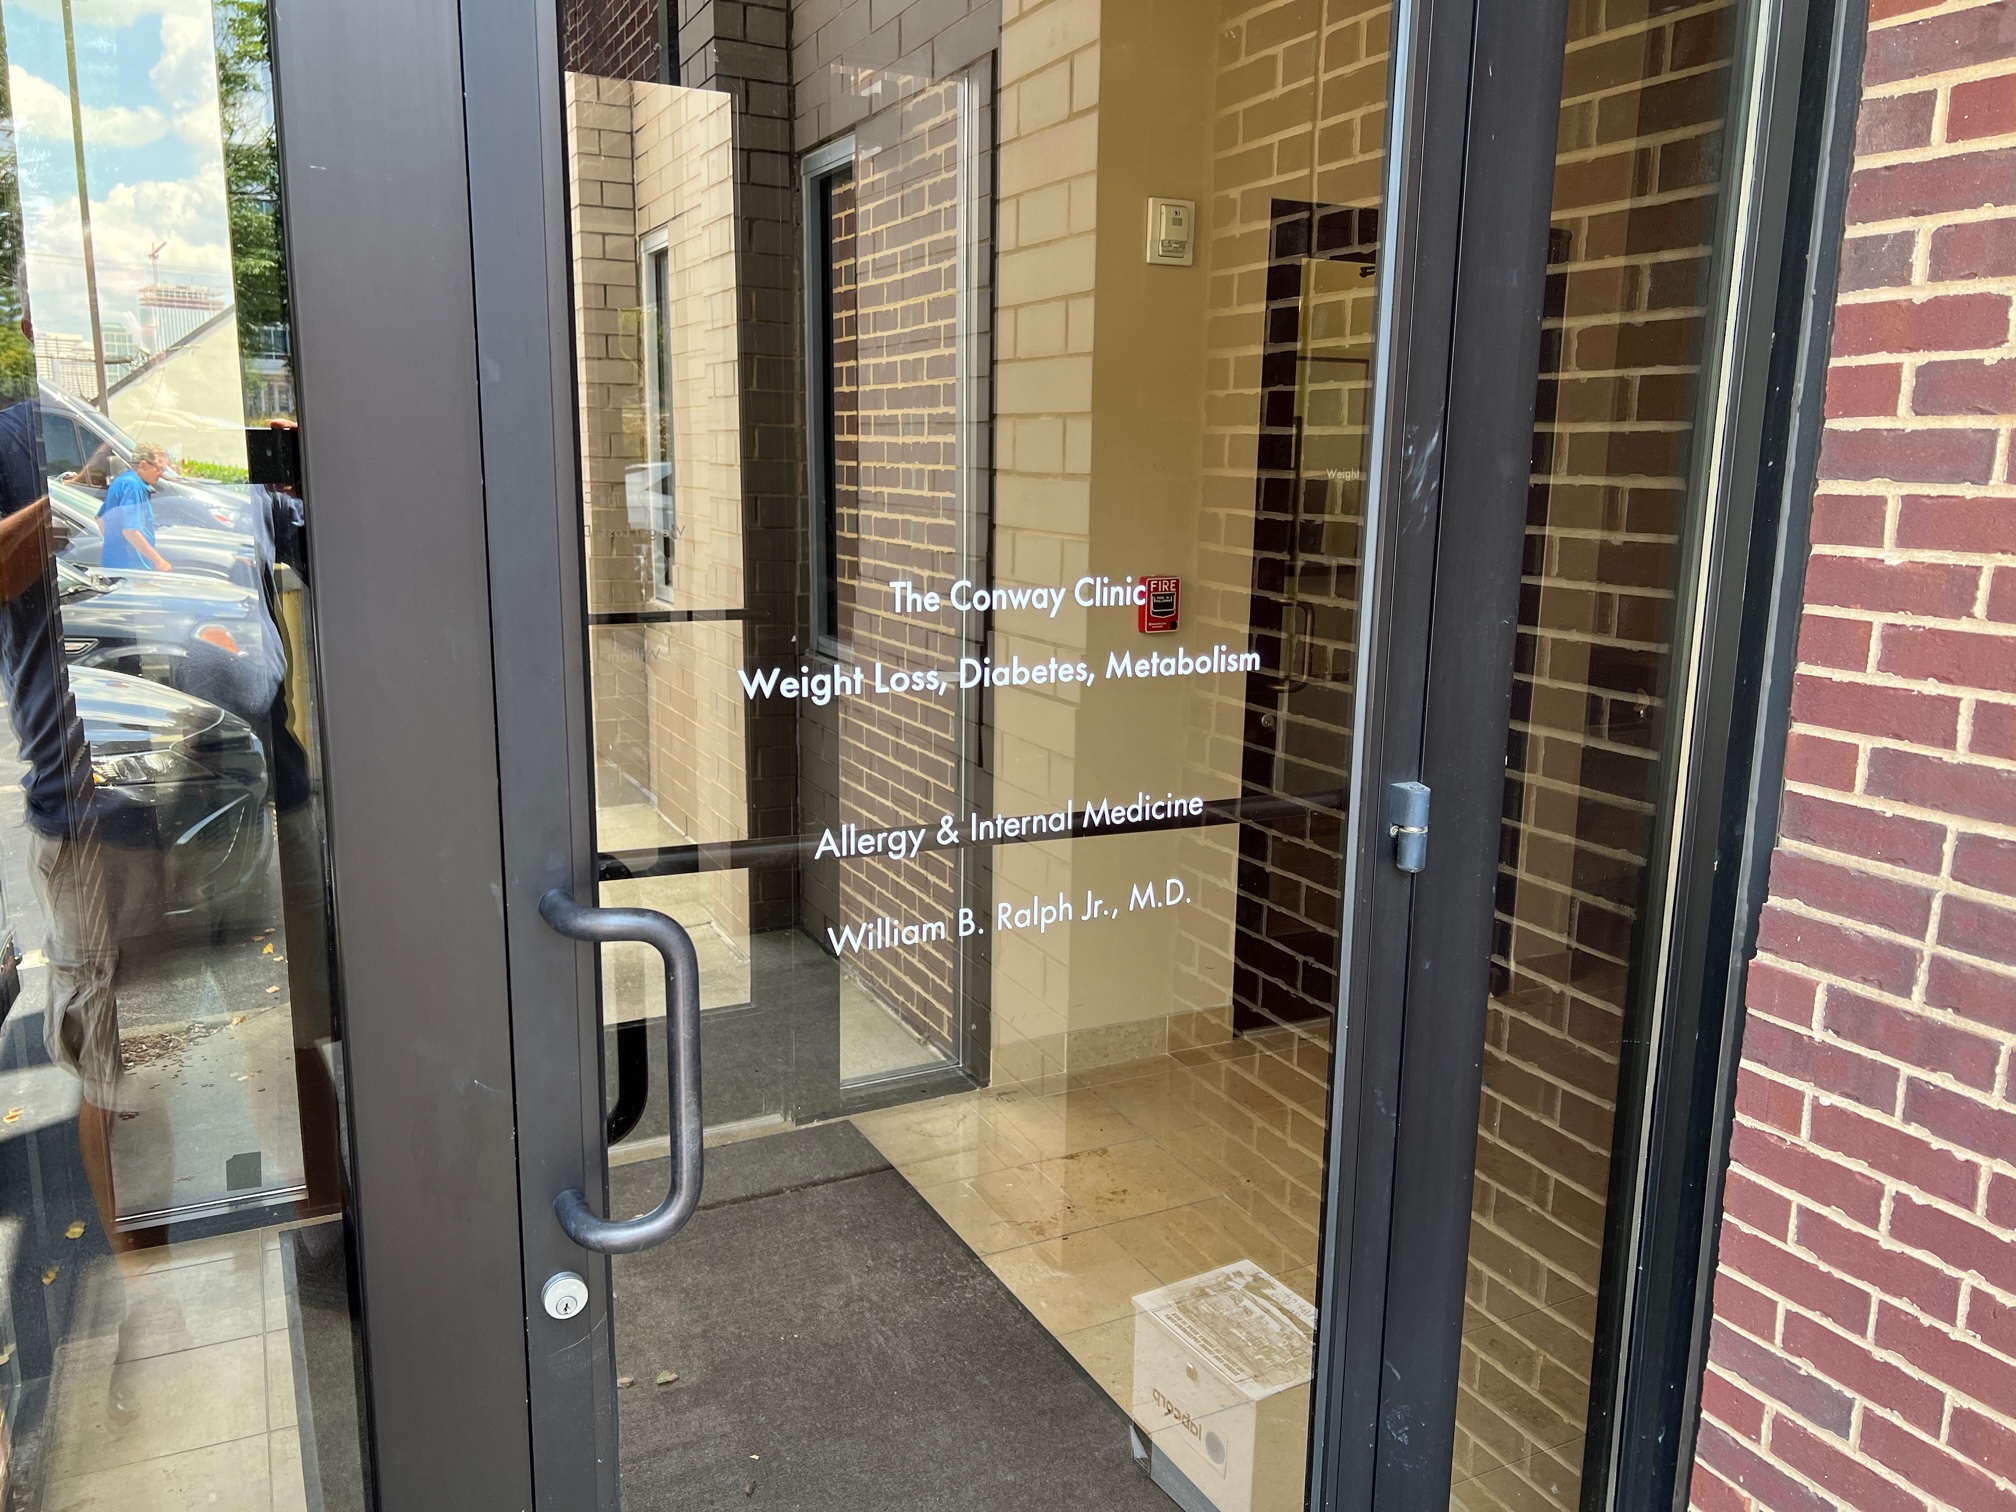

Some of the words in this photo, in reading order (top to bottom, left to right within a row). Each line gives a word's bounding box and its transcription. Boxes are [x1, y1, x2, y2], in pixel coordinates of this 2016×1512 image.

[1326, 468, 1361, 481] Weight
[889, 581, 941, 613] The
[950, 580, 1067, 619] Conway
[1074, 575, 1146, 607] Clinic
[1150, 579, 1177, 592] FIRE
[738, 664, 865, 706] Weight
[874, 661, 948, 696] Loss,
[959, 657, 1095, 693] Diabetes,
[1105, 645, 1260, 679] Metabolism
[814, 824, 926, 860] Allergy
[937, 816, 960, 845] &
[971, 800, 1073, 841] Internal
[1083, 792, 1204, 828] Medicine
[827, 917, 946, 957] William
[958, 908, 985, 937] B.
[997, 892, 1073, 934] Ralph
[1081, 890, 1118, 922] Jr.,
[1129, 878, 1192, 911] M.D.
